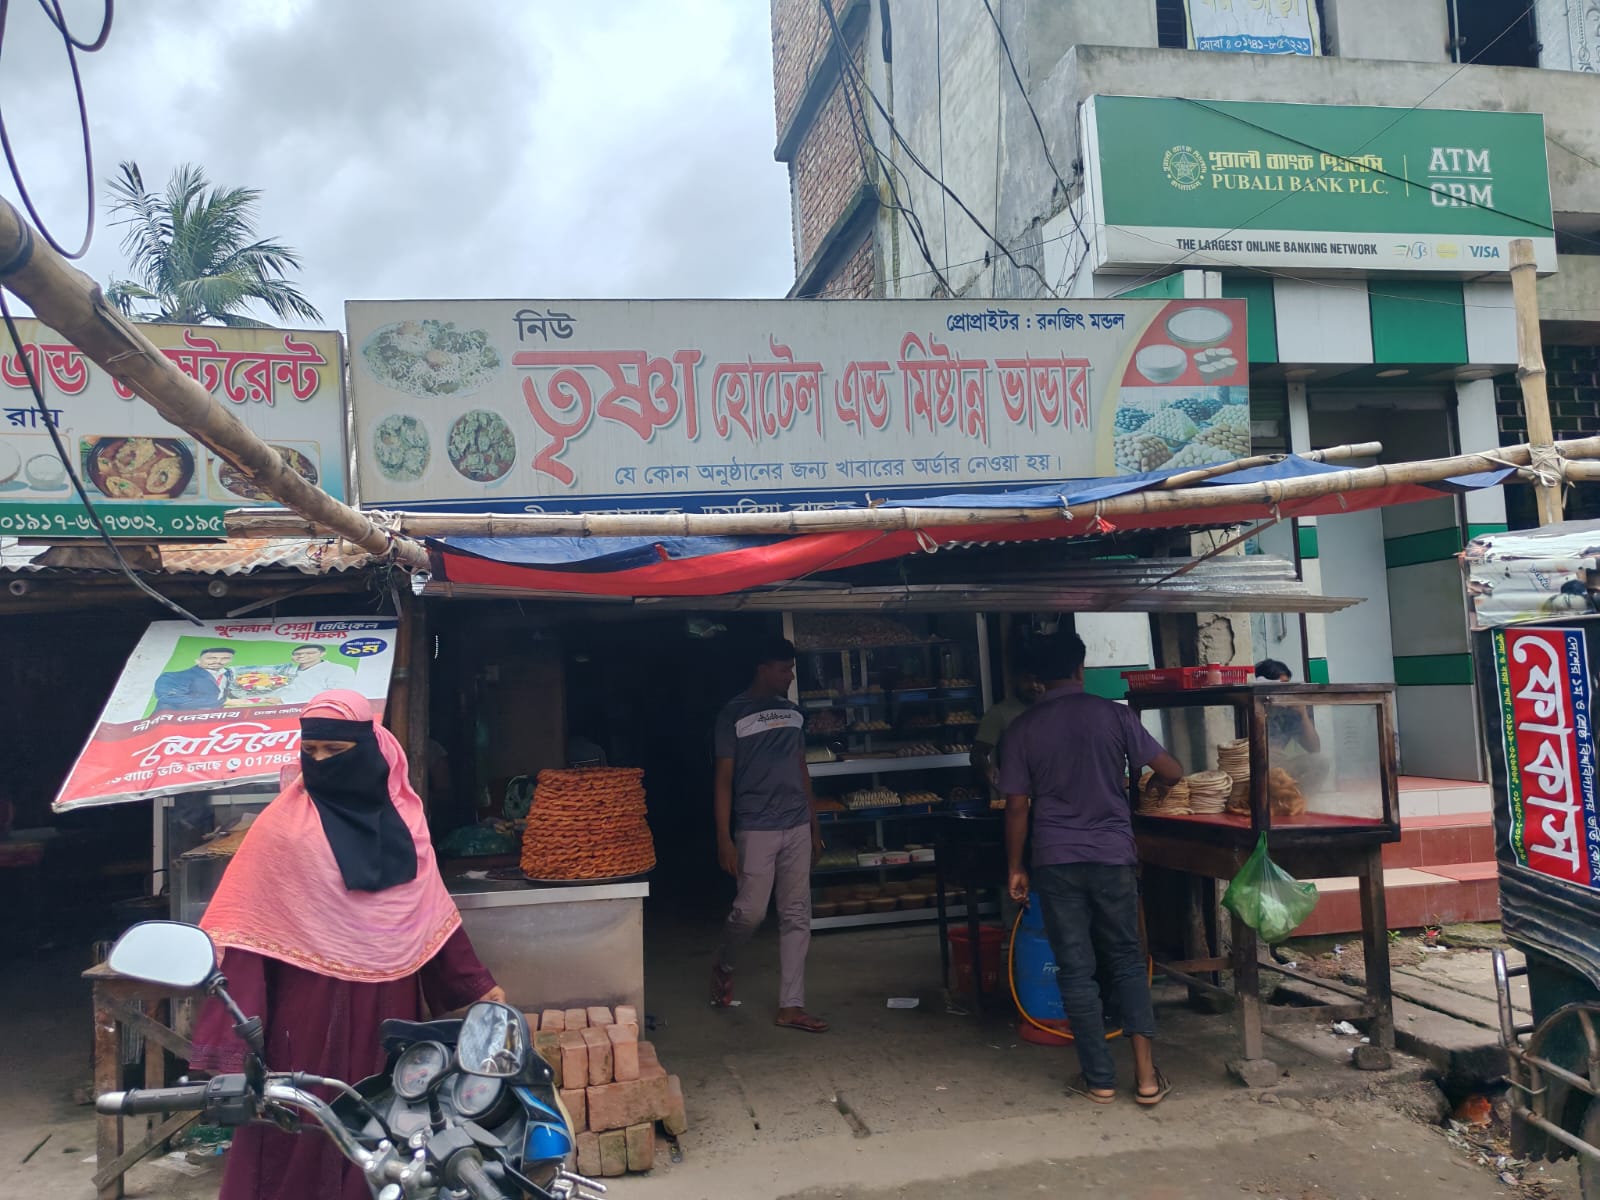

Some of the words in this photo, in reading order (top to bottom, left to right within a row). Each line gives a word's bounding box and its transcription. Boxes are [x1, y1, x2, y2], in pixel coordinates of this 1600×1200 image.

[1429, 147, 1491, 173] ATM
[1211, 173, 1284, 191] PUBALI
[1289, 176, 1344, 193] BANK
[1349, 179, 1389, 195] PLC.
[1430, 183, 1494, 208] CRM
[1176, 239, 1196, 250] THE
[1198, 239, 1243, 251] LARGEST
[1245, 241, 1281, 252] ONLINE
[1284, 241, 1328, 254] BANKING
[1330, 243, 1378, 255] NETWORK
[1468, 245, 1500, 258] VISA
[513, 309, 577, 342] নিউ
[947, 308, 1020, 332] প্রোপ্রাইটর
[1035, 308, 1085, 331] রনজিৎ
[512, 350, 702, 486] তৃষ্ণা
[712, 333, 824, 443] হোটেল
[834, 360, 893, 433] এন্ড
[897, 331, 990, 446] মিষ্টান্ন
[995, 350, 1092, 432] ভান্ডার
[614, 466, 637, 485] যে
[644, 464, 690, 484] কোন
[696, 456, 784, 486] অনুষ্ঠানের
[789, 461, 829, 480] জন্য
[835, 458, 905, 478] খাবারের
[912, 452, 961, 475] অর্ডার
[967, 455, 1019, 474] নেওয়া
[1024, 454, 1051, 472] হয়
[171, 515, 227, 532] ০১৯৫
[244, 750, 301, 767] 01786-
[1513, 635, 1582, 875] ফোকাস
